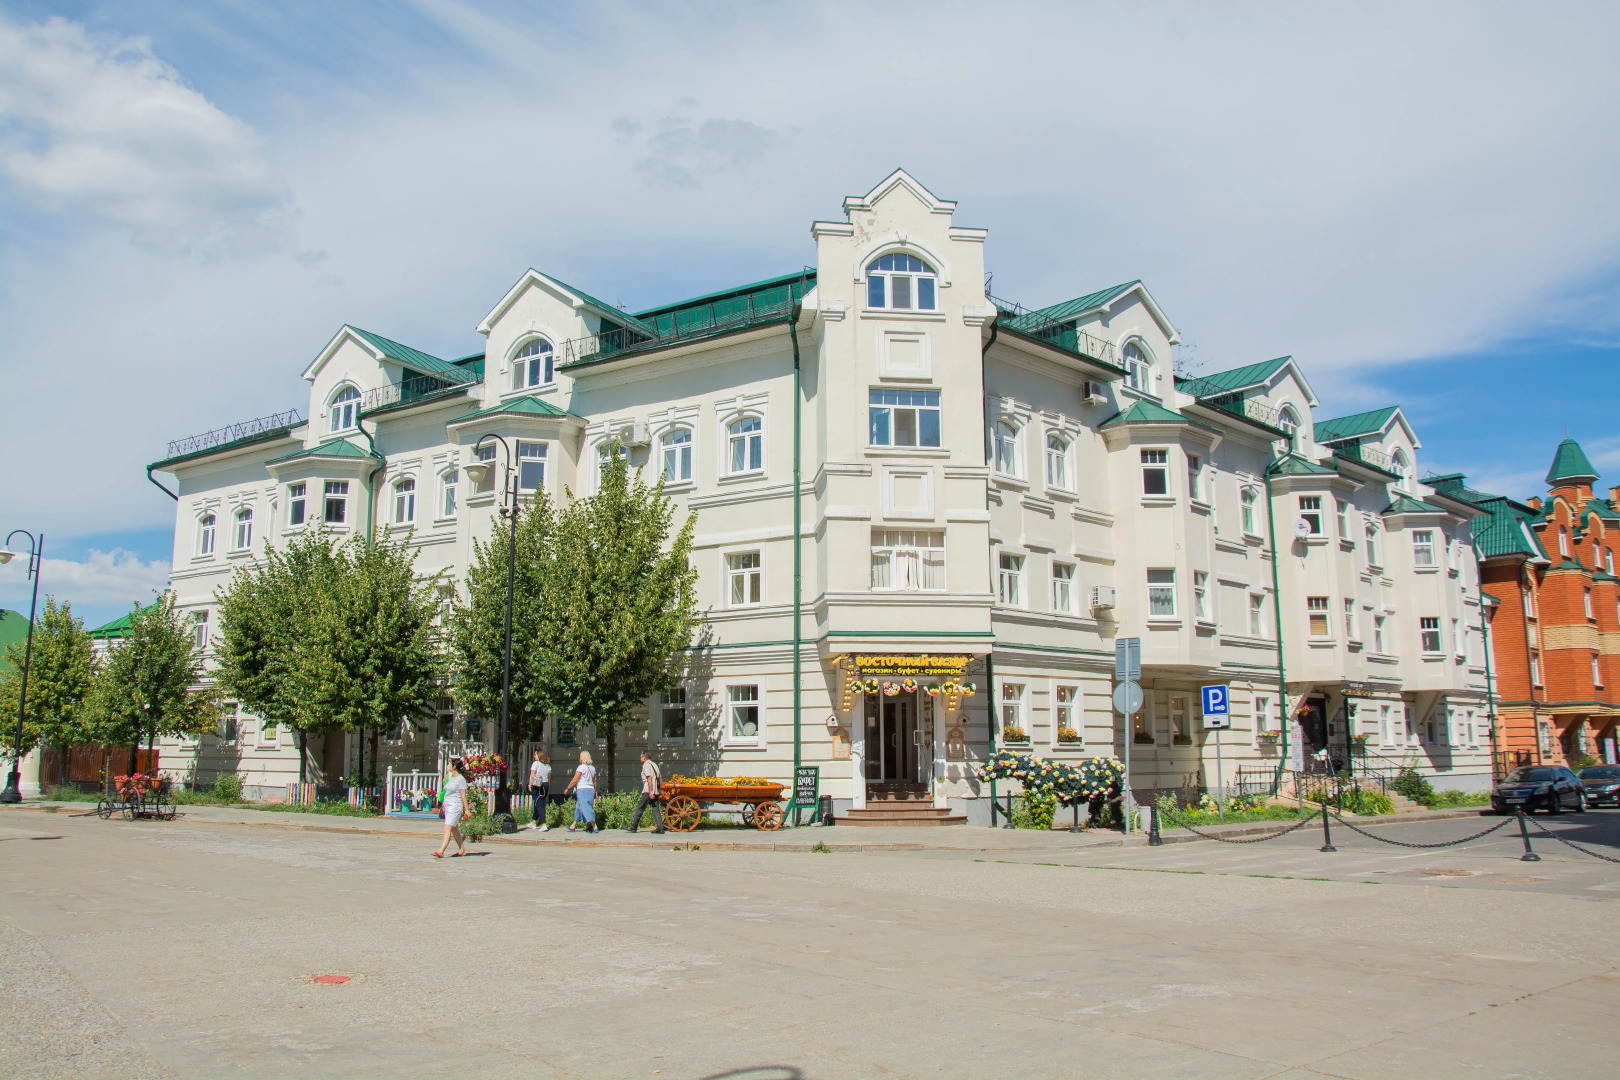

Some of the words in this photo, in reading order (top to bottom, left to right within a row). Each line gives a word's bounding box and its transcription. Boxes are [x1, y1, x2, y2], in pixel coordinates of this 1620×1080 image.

[856, 654, 929, 666] ВОСТОЧНЫЙ
[931, 656, 968, 666] БАЗАР
[897, 667, 919, 675] буфет
[1208, 688, 1223, 712] P
[797, 776, 815, 786] БУФЕТ
